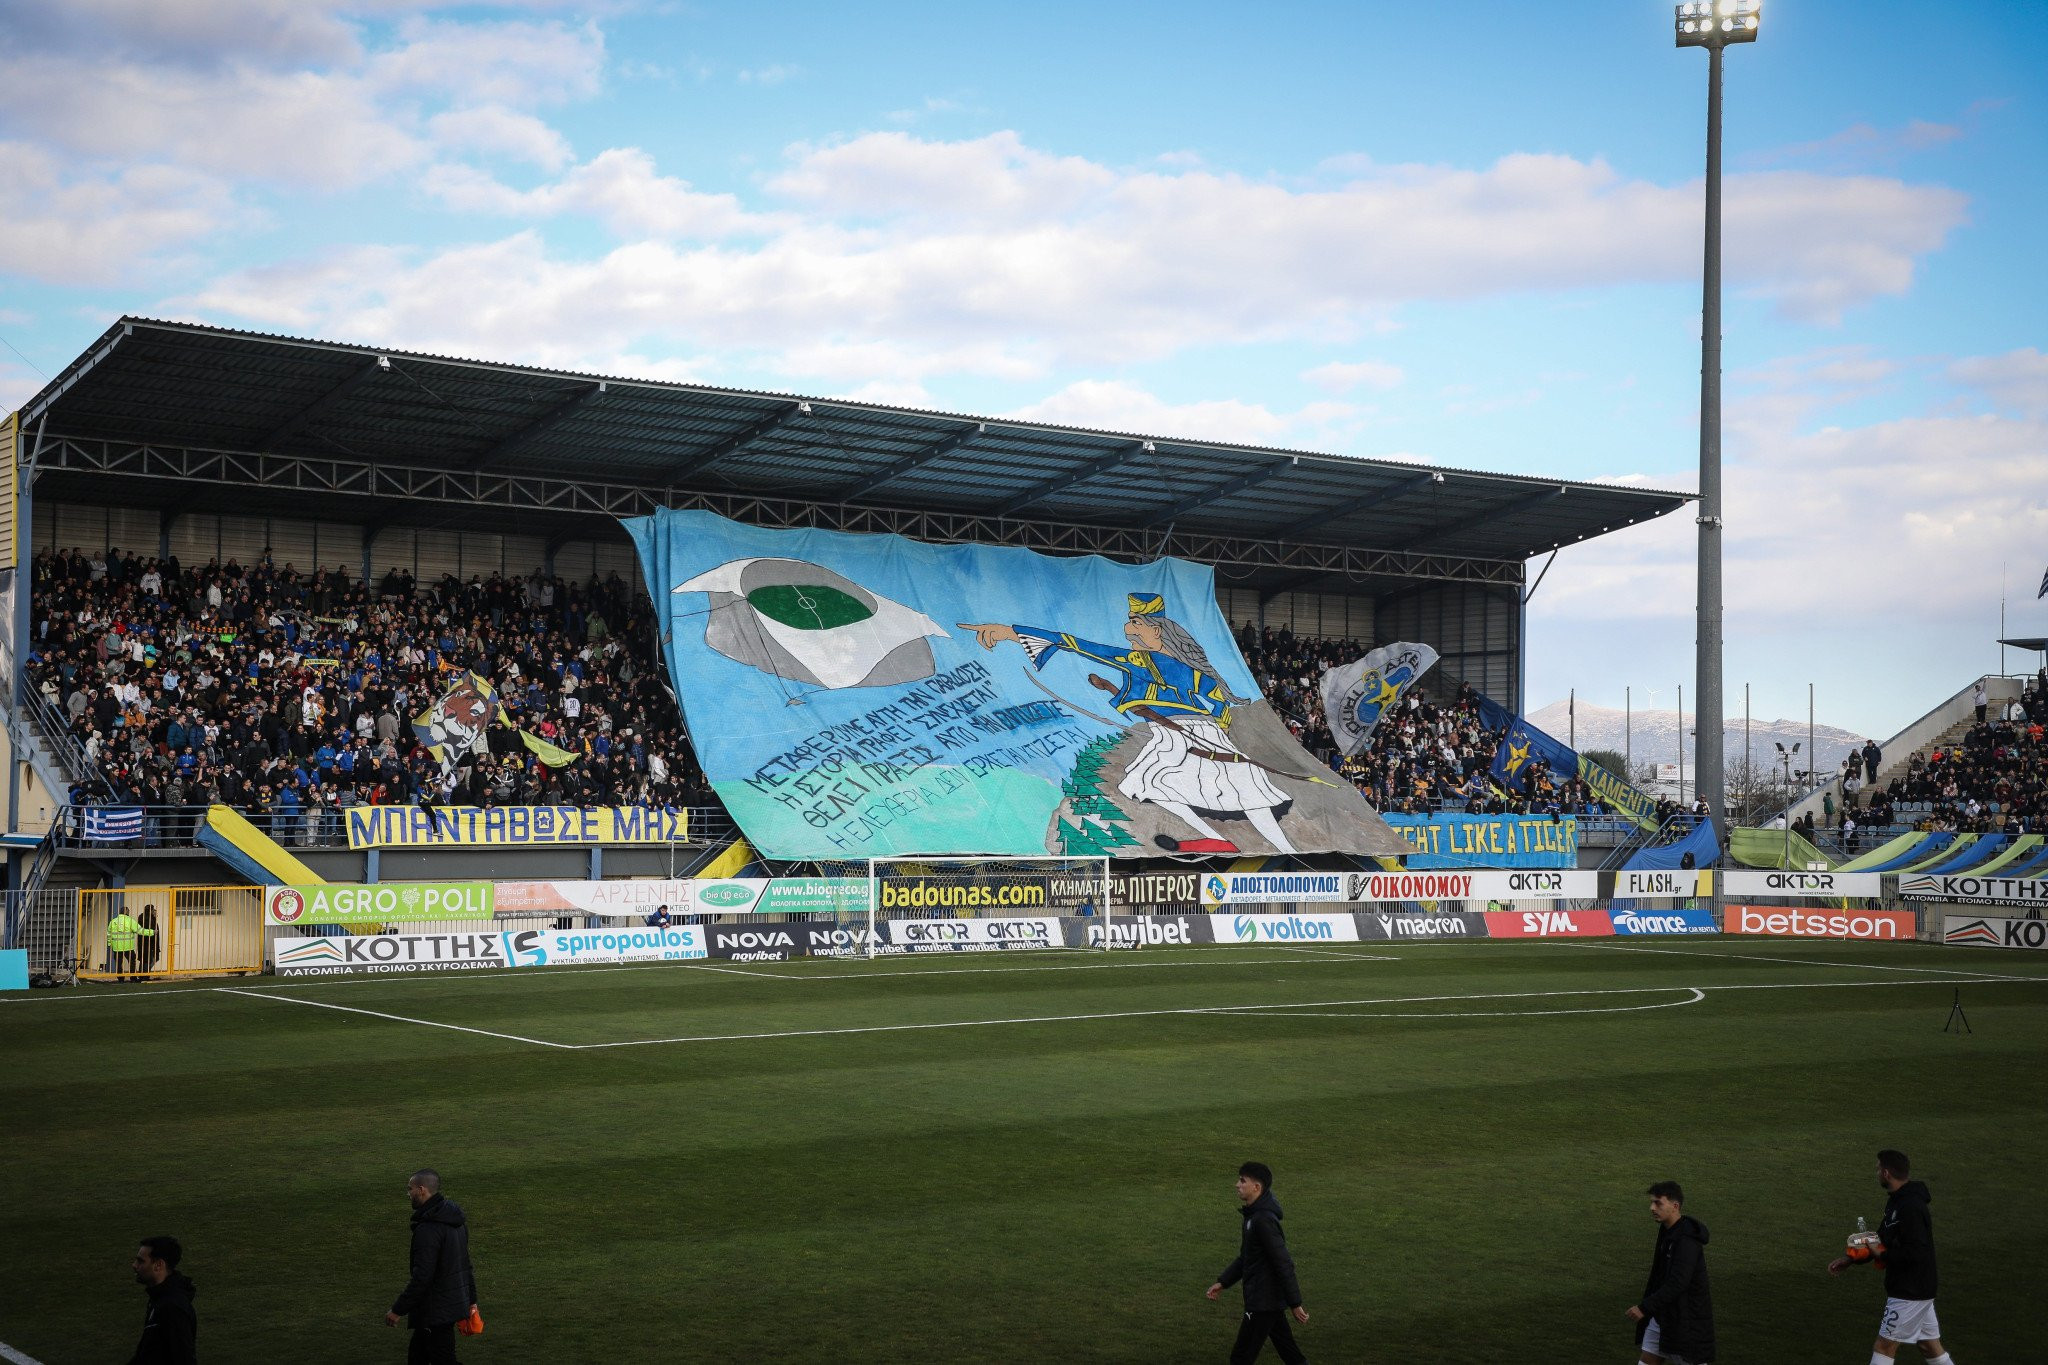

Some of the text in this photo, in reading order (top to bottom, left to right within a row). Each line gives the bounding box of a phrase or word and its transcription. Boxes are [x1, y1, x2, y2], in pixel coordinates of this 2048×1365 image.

[743, 660, 992, 794] ΜΕΤΑΦΕΡΟΥΜΕ ΑΥΤΗ ΤΗΝ ΠΑΡΑΔΟΣΗ
[774, 792, 803, 810] Η
[857, 724, 915, 760] ΓΡΑΦΕΙ
[803, 777, 871, 828] ΘΕΛΕΙ
[860, 744, 943, 786] ΠΡΑΞΕΙΣ
[934, 725, 979, 751] ΑΥΤΟ
[826, 832, 855, 850] Η
[843, 787, 940, 842] ΕΛΕΥΘΕΡΙΑ
[935, 767, 970, 794] ΔΕΝ
[962, 748, 1028, 778] ΕΡΧΕΤΑΙ
[613, 806, 686, 841] ΜΑΣ
[1448, 822, 1504, 854] LIKE
[1507, 822, 1518, 855] A
[1518, 820, 1577, 854] TIGER
[591, 881, 691, 904] ΑΡΣΕΝΗΣ
[771, 882, 870, 898] www.biogreco.g
[882, 880, 1045, 908] badounas.com
[1129, 874, 1197, 904] ΠΙΤΕΡΟΣ
[1230, 876, 1340, 894] ΑΠΟΣΤΟΛΟΠΟΥΛΟΣ
[1630, 873, 1682, 894] FLASH.gr
[310, 887, 487, 915] AGRO POLI
[669, 904, 690, 912] ΚΤΕΟ
[1903, 894, 1949, 903] ΛΑΤΟΜΕΙΑ
[1957, 897, 1992, 905] ΕΤΟΙΜΟ
[1261, 916, 1333, 939] volton
[1395, 918, 1467, 934] macron
[1522, 912, 1578, 936] SYM
[1626, 916, 1688, 934] avance
[1742, 907, 1896, 938] betsson
[2004, 920, 2048, 948] ΚΟ
[344, 934, 500, 963] ΚΟΤΤΗΣ
[556, 928, 694, 957] spiropoulos
[717, 932, 795, 948] NOVA
[809, 930, 884, 946] NOVA
[814, 945, 857, 955] novibet
[913, 942, 954, 952] novibet
[961, 941, 1001, 951] novibet
[1007, 939, 1047, 950] novibet
[583, 956, 612, 964] ΘΑΛΑΜΟΙ
[617, 954, 660, 963] ΚΛΙΜΑΤΙΣΜΟΣ
[663, 949, 706, 960] DAIKIN
[731, 950, 783, 962] novibet
[283, 966, 354, 977] ΛΑΤΟΜΕΙΑ
[367, 963, 417, 974] ΕΤΟΙΜΟ
[420, 960, 497, 972] ΣΚΥΡΟΔΕΜΑ
